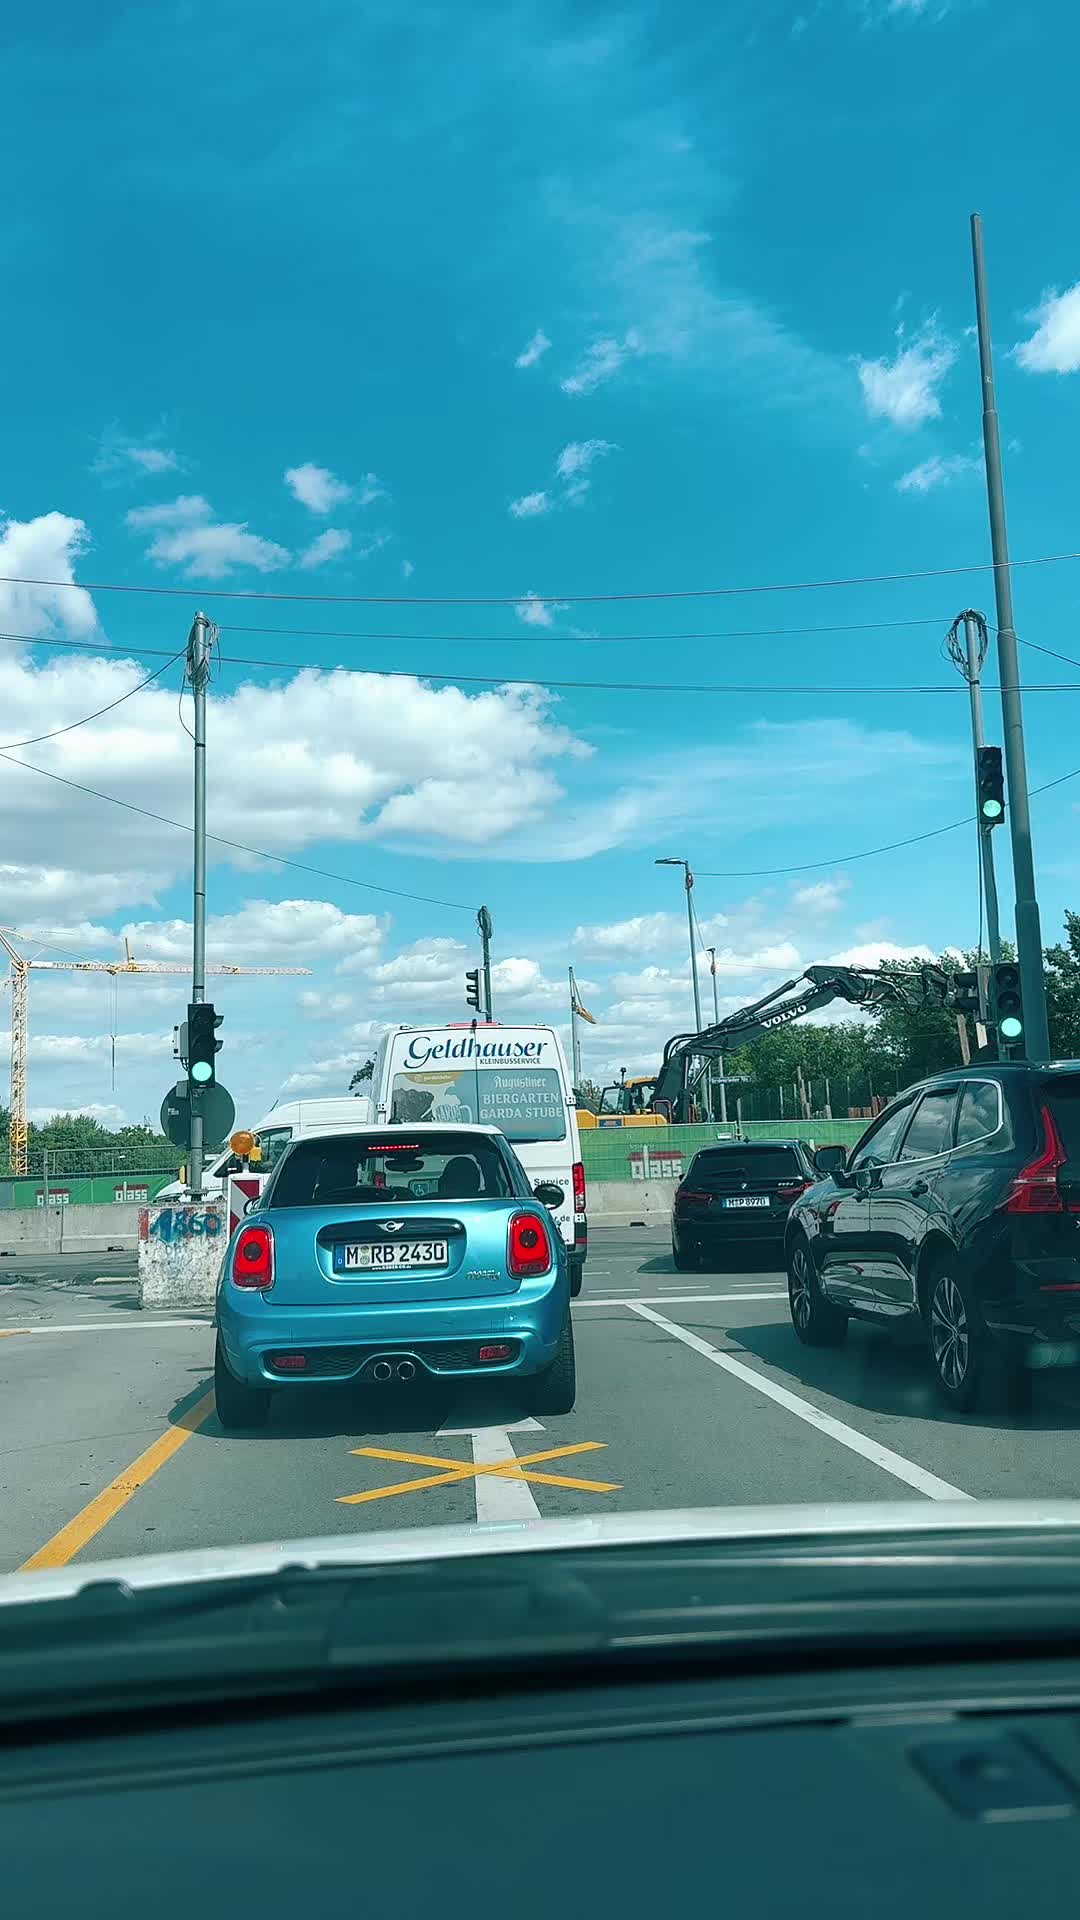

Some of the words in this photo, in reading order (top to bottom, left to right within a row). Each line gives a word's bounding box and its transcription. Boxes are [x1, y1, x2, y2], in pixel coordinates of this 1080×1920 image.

[761, 1004, 807, 1029] VOLVO
[403, 1036, 548, 1069] Geldhauser
[494, 1075, 546, 1089] Augustiner
[482, 1092, 559, 1104] BIERGARTEN
[480, 1107, 522, 1119] GARDA
[525, 1106, 563, 1118] STUBE
[36, 1193, 69, 1207] gass
[115, 1181, 148, 1202] glass
[150, 1209, 221, 1242] 1860
[346, 1246, 358, 1265] M
[371, 1245, 395, 1264] RB
[400, 1242, 445, 1263] 2430
